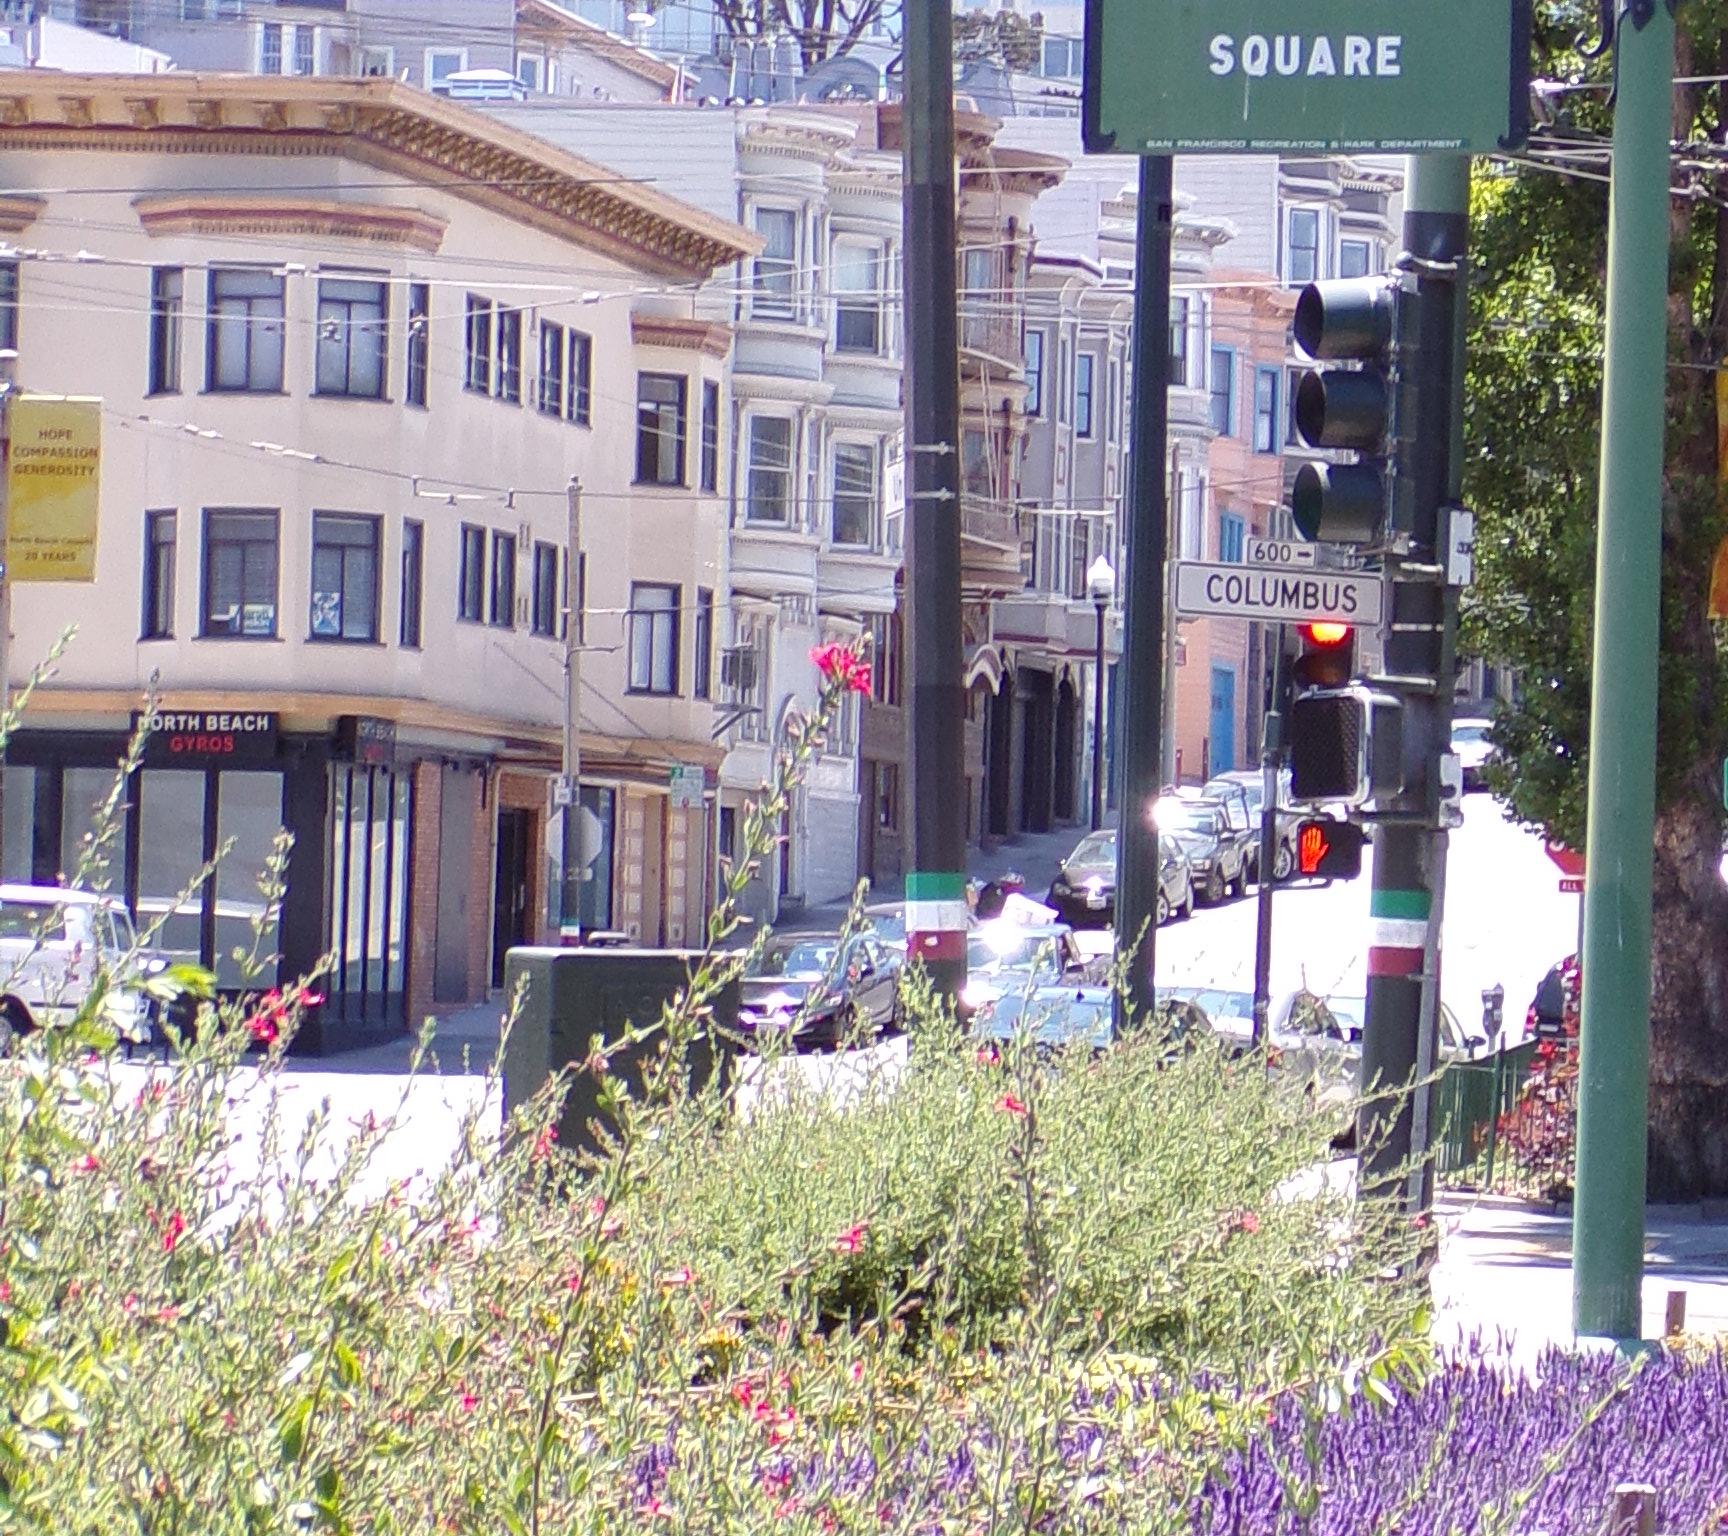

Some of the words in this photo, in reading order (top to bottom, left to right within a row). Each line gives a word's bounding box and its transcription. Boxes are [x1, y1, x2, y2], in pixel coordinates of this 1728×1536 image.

[1209, 33, 1402, 77] SQUARE
[1147, 139, 1172, 148] SAN
[1177, 139, 1247, 148] FRANCISCO
[1251, 139, 1326, 149] RECREATION
[1344, 140, 1376, 149] PARK
[1381, 140, 1462, 149] DEPARTMENT
[38, 429, 73, 441] HOPE
[13, 445, 99, 459] COMPASSION
[14, 464, 96, 477] GENEROSITY
[1254, 542, 1292, 562] 600
[1206, 573, 1358, 613] COLUMBUS
[206, 714, 270, 732] BEACH
[169, 735, 235, 753] GYROS
